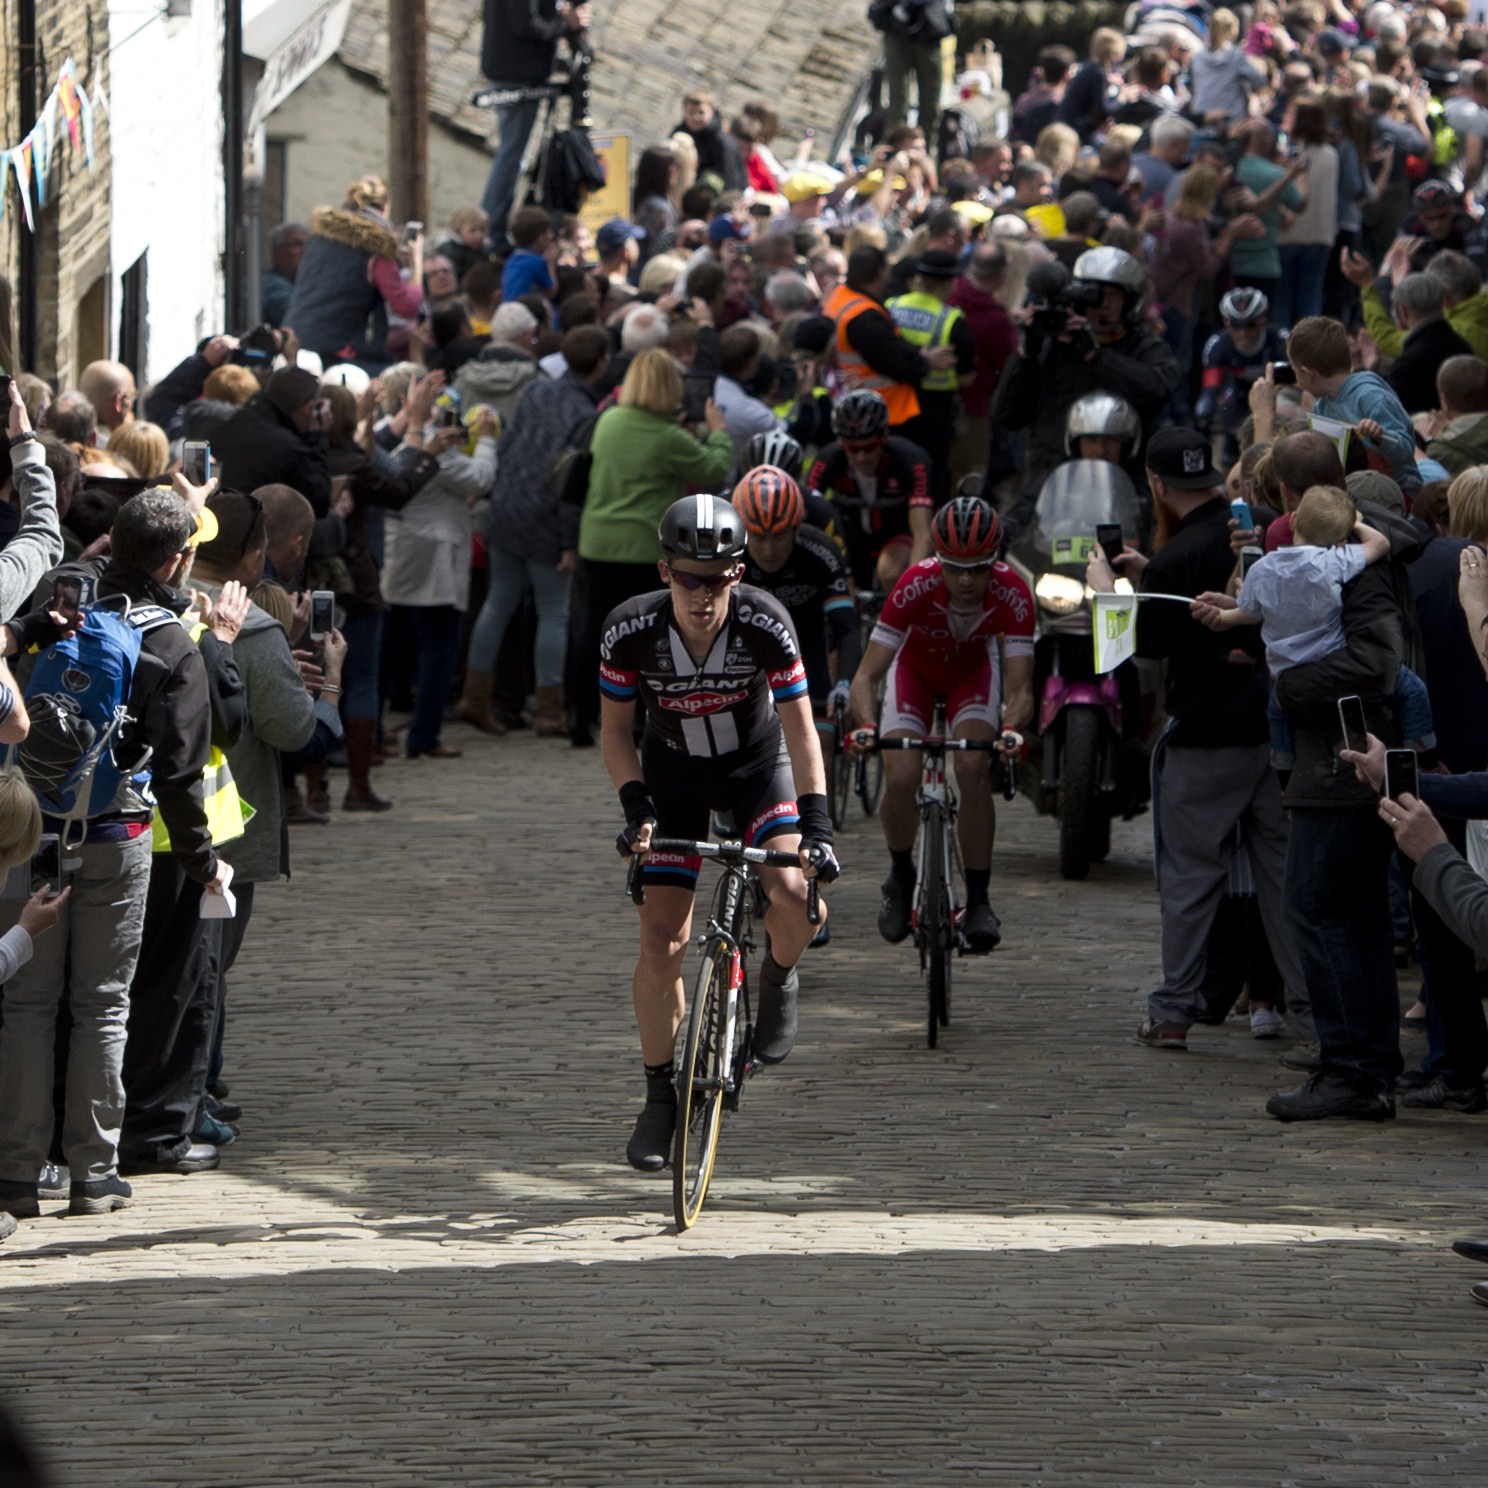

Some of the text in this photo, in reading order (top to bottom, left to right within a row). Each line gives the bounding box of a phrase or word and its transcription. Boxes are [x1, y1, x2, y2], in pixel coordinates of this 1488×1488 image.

[604, 612, 658, 649] GIANT
[751, 613, 797, 656] GIANT
[666, 676, 754, 693] GIANT
[668, 693, 740, 712] Alpecin
[751, 803, 793, 833] Alpecin
[648, 853, 685, 864] lpecin
[723, 875, 738, 932] GIANT
